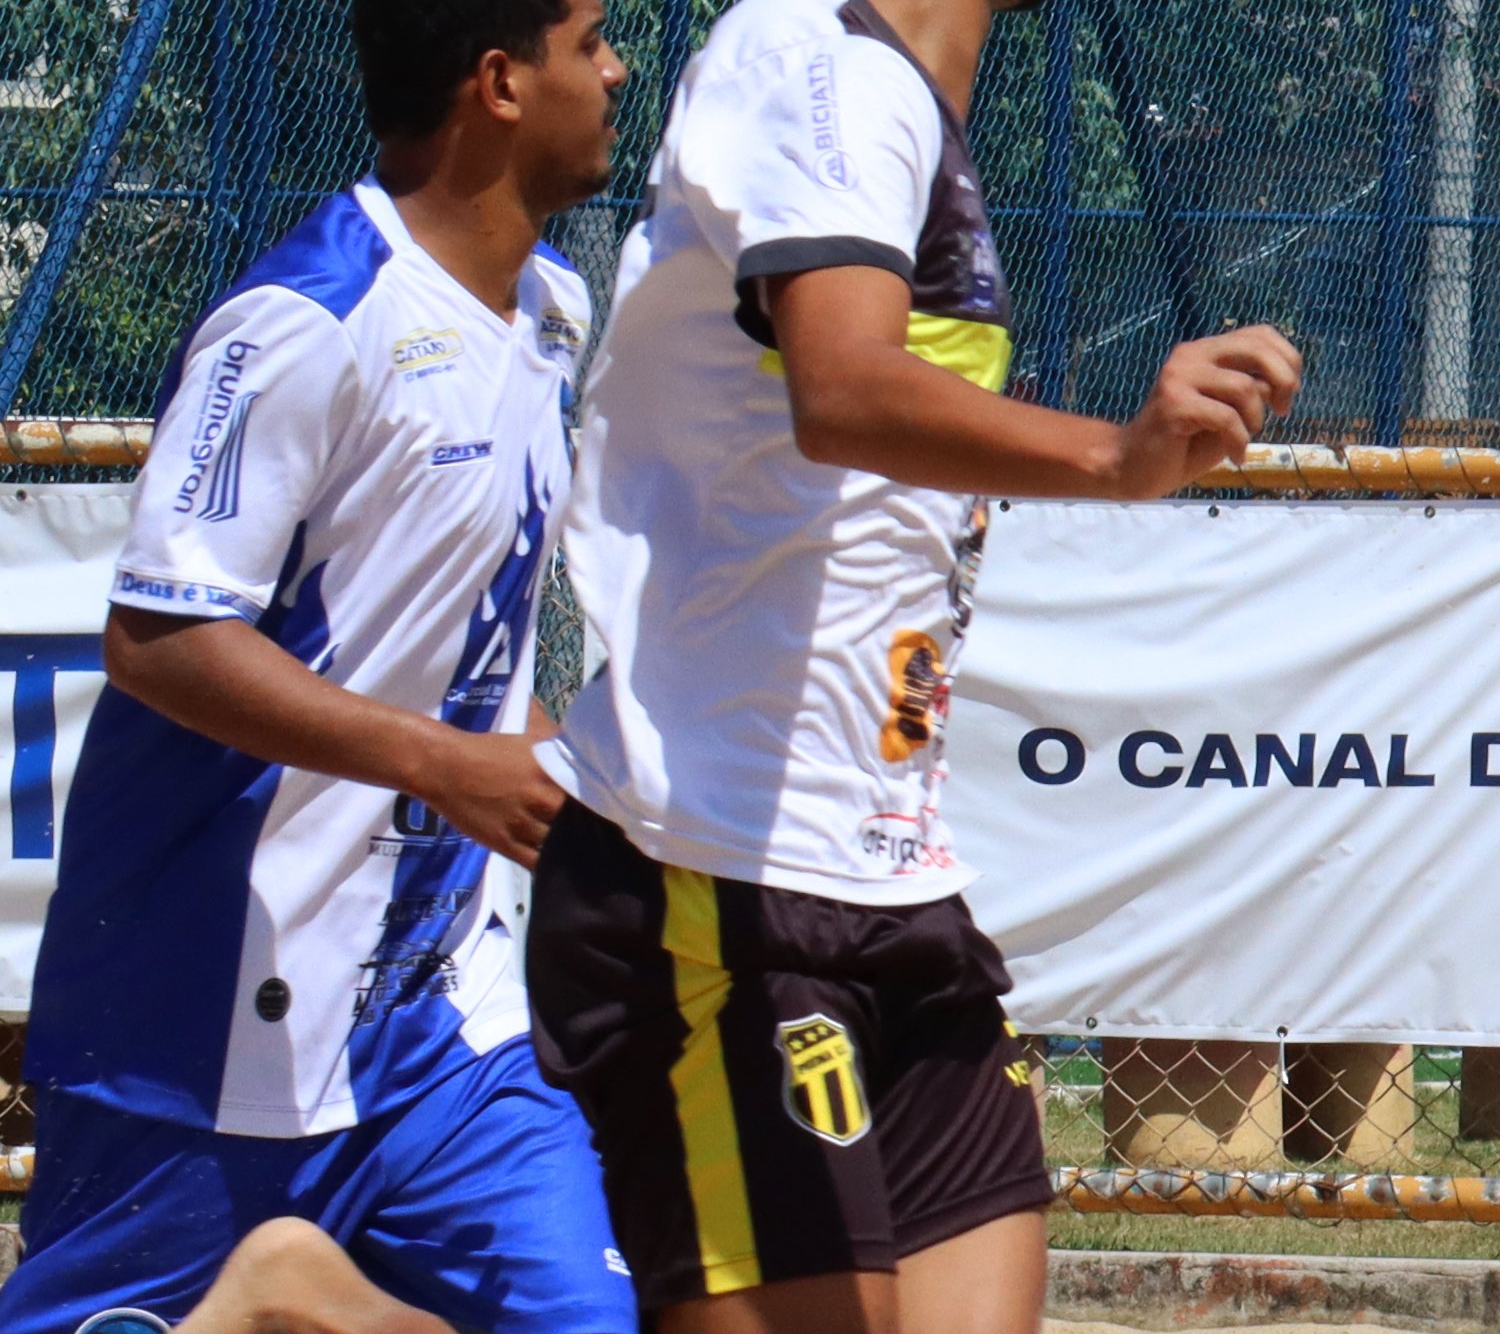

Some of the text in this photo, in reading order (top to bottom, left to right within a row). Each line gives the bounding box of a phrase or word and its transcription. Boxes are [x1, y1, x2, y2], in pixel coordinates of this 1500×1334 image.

[172, 339, 261, 515] brumagran
[119, 572, 174, 601] Deus
[182, 583, 198, 602] é
[1018, 727, 1086, 785] O
[1118, 730, 1435, 789] CANAL
